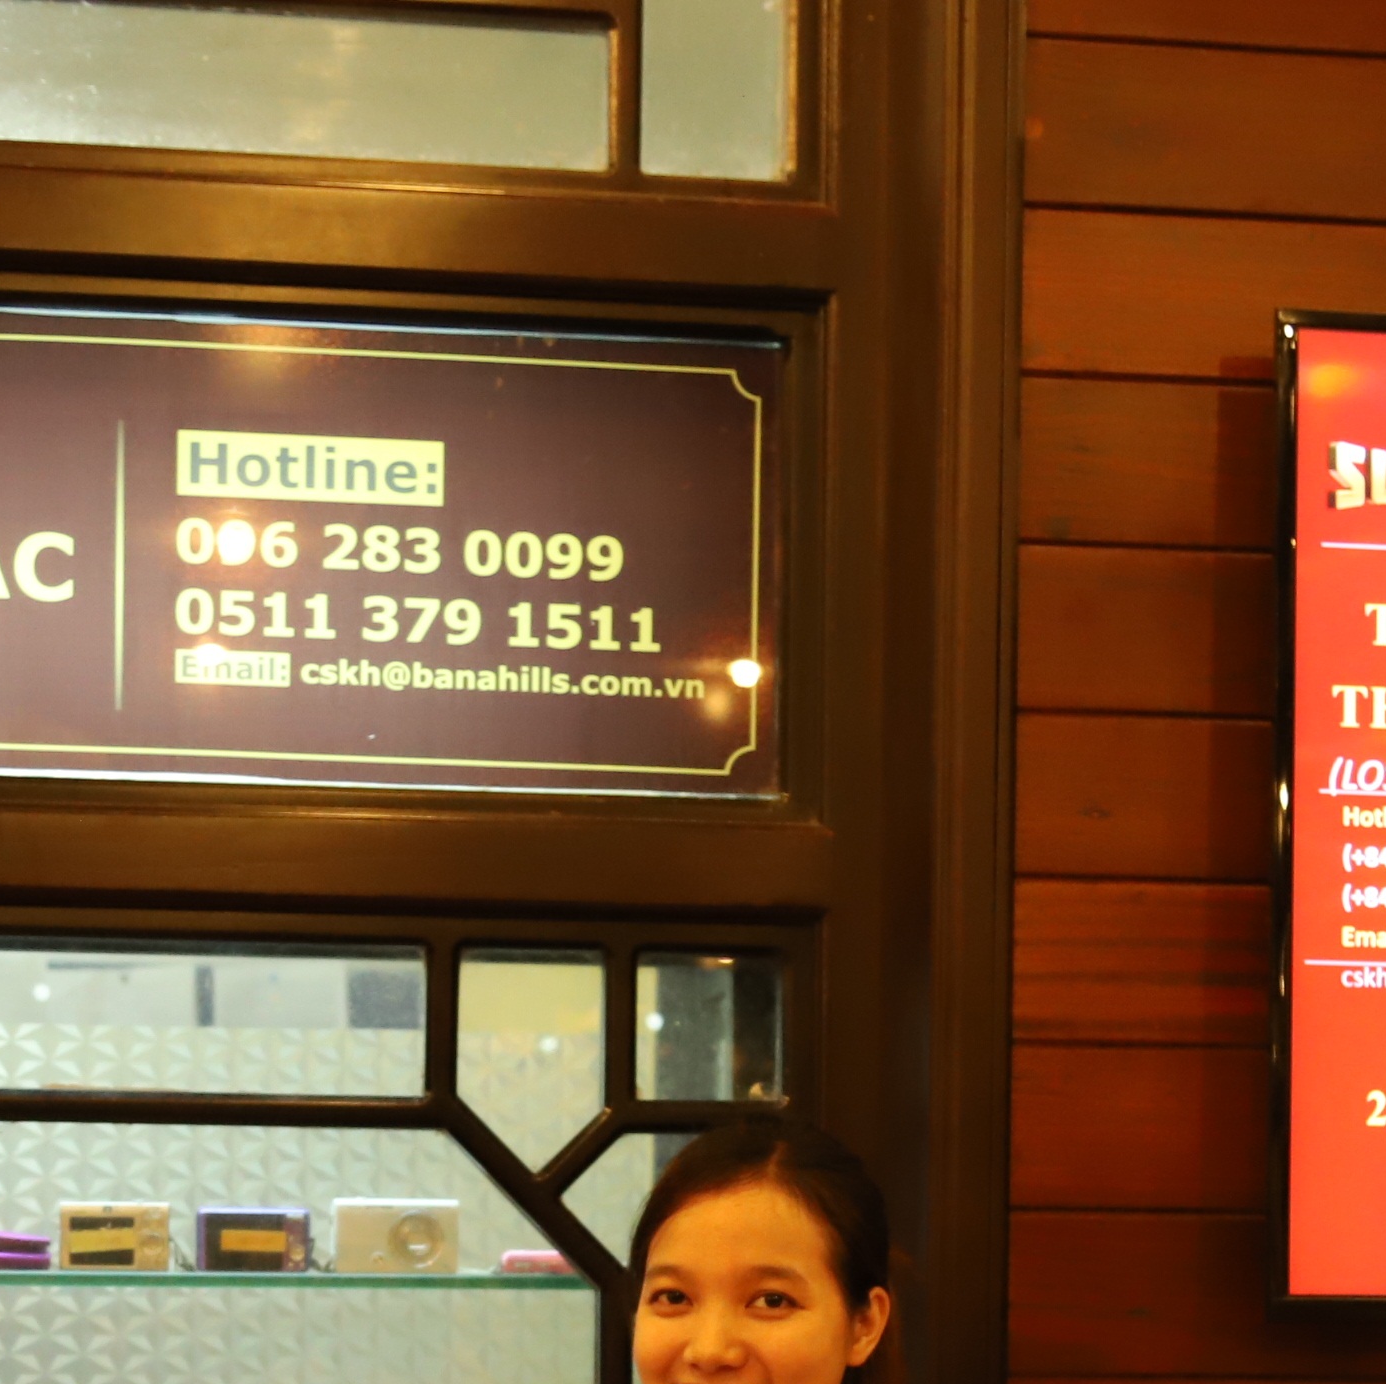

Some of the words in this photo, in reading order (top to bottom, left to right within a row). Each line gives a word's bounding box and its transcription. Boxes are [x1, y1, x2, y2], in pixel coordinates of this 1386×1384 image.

[188, 441, 440, 494] Hotline:
[323, 523, 441, 574] 283
[463, 530, 624, 582] 0099
[175, 588, 336, 640] 0511
[361, 596, 481, 645] 379
[507, 602, 662, 653] 1511
[182, 655, 288, 681] Email:
[300, 658, 705, 699] cskh@banahills.com.vn
